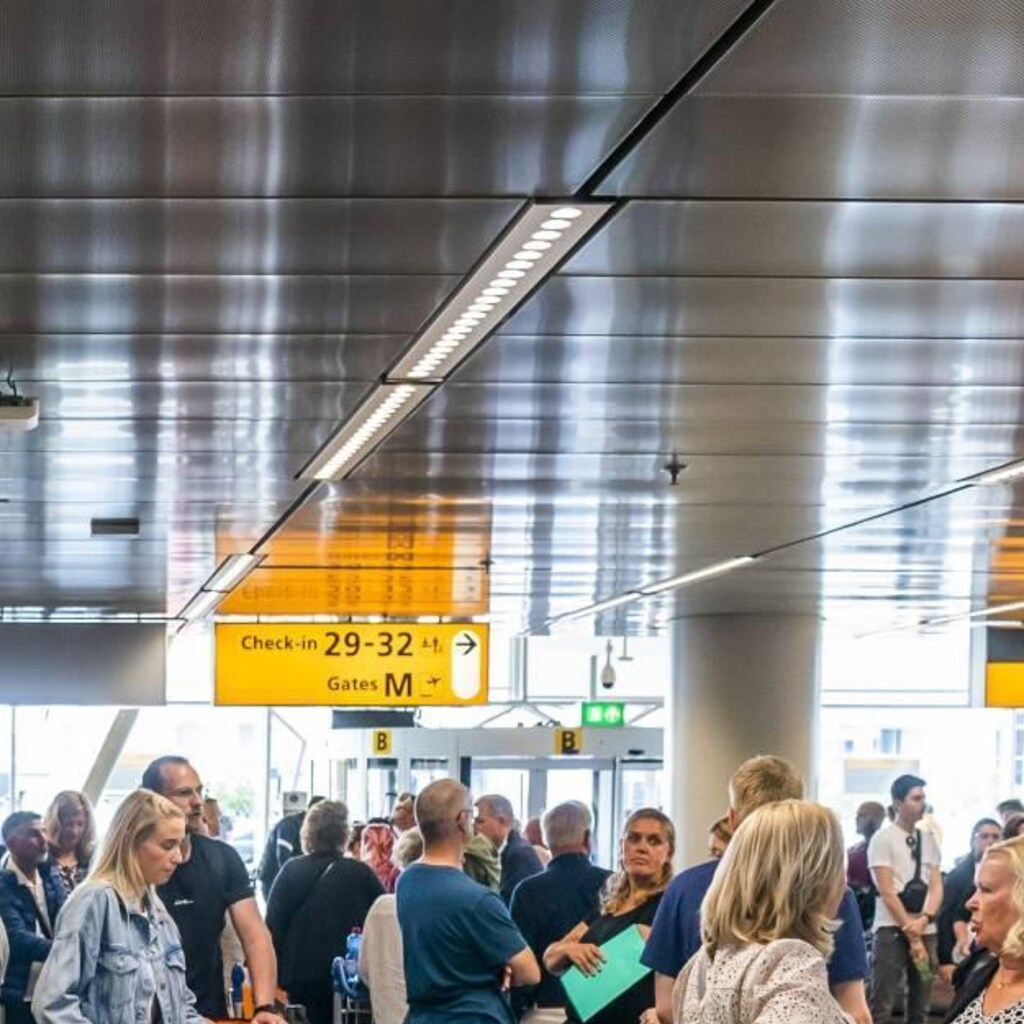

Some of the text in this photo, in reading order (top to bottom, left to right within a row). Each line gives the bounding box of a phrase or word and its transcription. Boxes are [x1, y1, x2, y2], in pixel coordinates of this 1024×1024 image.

[241, 632, 412, 656] Check-in 29-32
[327, 673, 412, 696] Gates M
[377, 732, 387, 750] B
[562, 731, 575, 749] B
